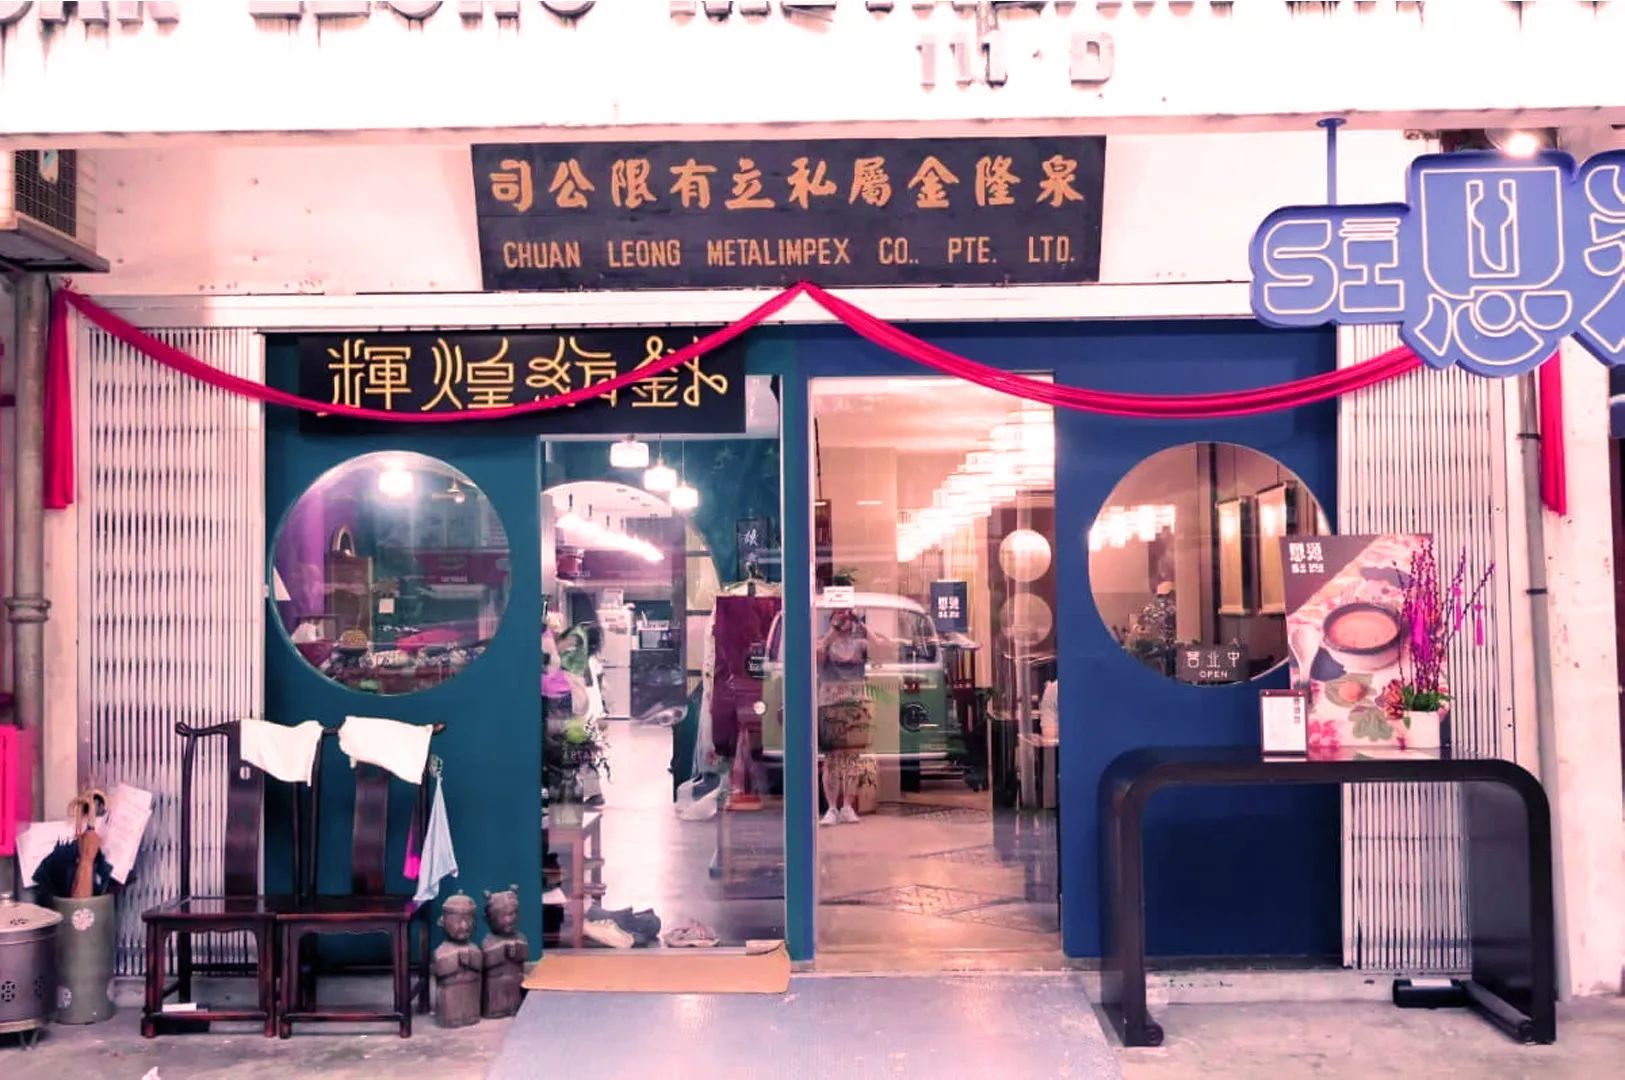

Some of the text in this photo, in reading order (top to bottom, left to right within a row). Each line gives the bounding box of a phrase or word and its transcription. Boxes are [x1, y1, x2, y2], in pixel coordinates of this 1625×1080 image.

[503, 241, 582, 269] CHUAN
[607, 239, 682, 268] LEONG
[707, 236, 851, 267] METALIMPEX
[947, 236, 997, 264] PTE.
[1028, 236, 1076, 264] LTD.
[1199, 670, 1228, 678] OPEN
